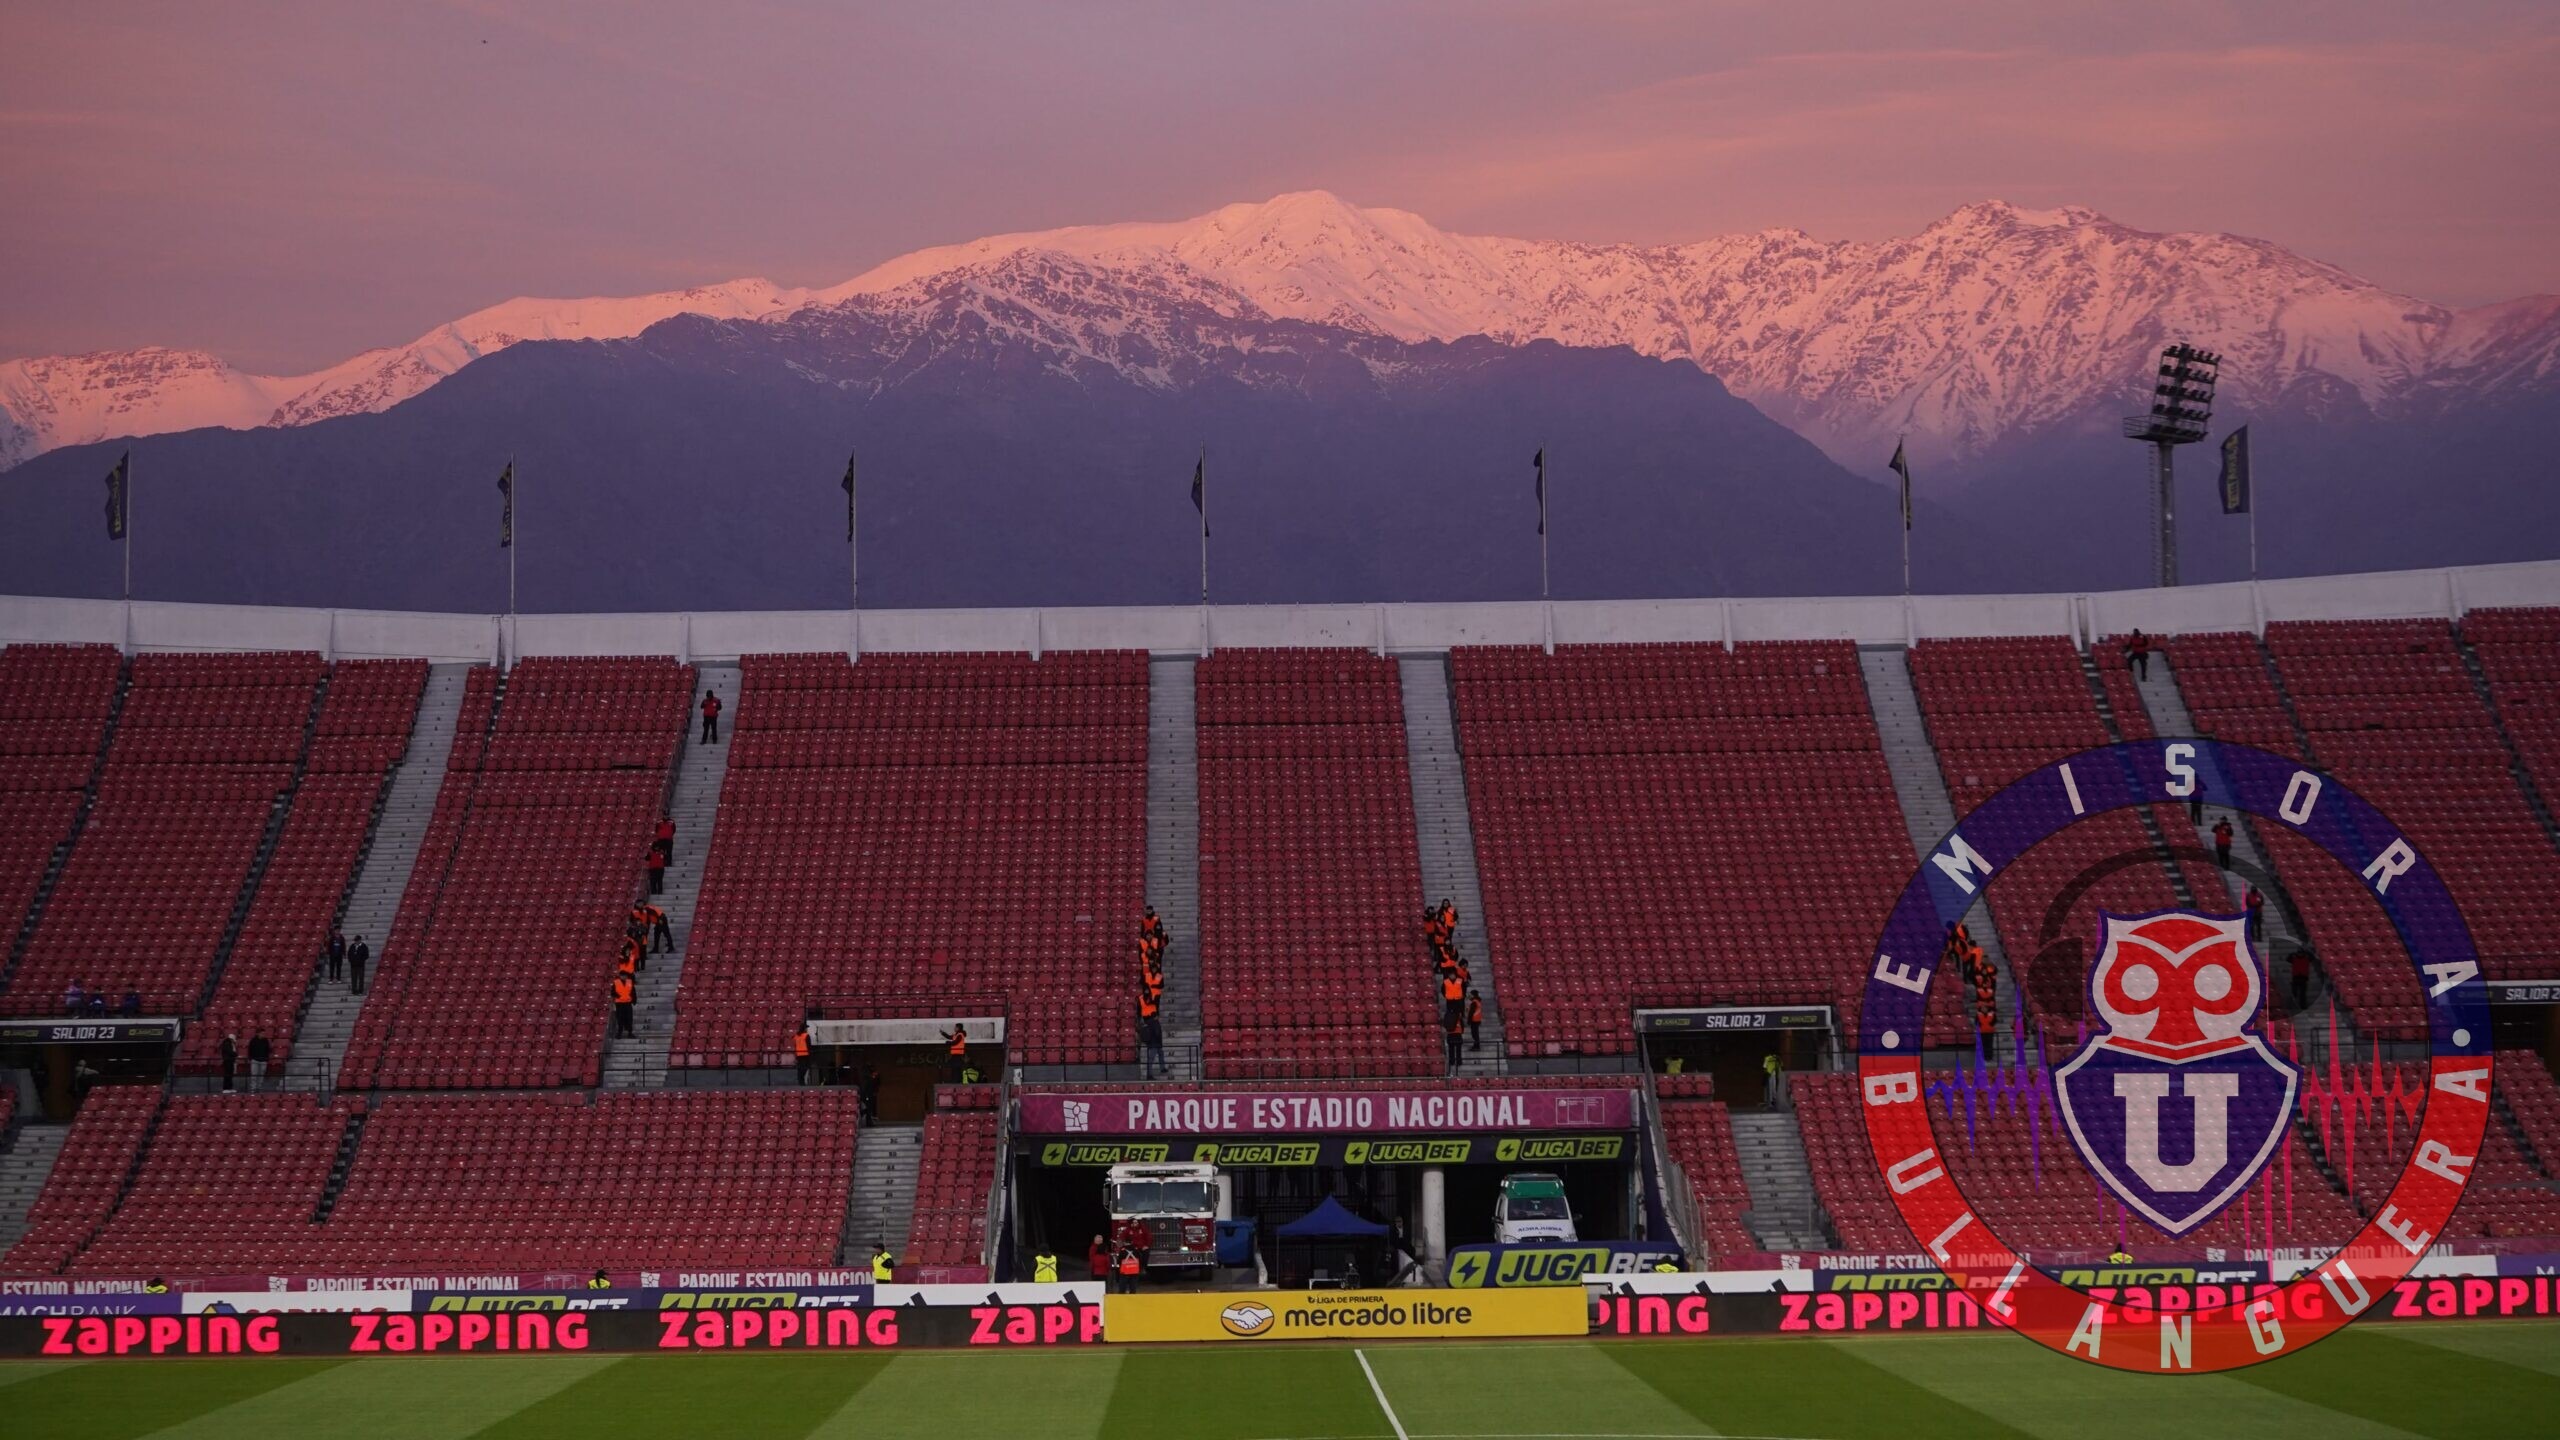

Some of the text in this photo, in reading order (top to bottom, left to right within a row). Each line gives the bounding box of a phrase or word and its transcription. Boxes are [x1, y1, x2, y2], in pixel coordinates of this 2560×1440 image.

[2505, 988, 2550, 1000] SALIDA
[2551, 987, 2560, 1000] 2
[1706, 1015, 1750, 1027] SALIDA
[1753, 1014, 1766, 1027] 21
[52, 1027, 96, 1039] SALIDA
[98, 1026, 115, 1039] 23
[1128, 1095, 1531, 1132] PARQUE ESTADIO NACIONAL
[1316, 1296, 1336, 1304] LIGA
[1349, 1295, 1384, 1303] PRIMERA
[1285, 1302, 1472, 1327] mercado libre
